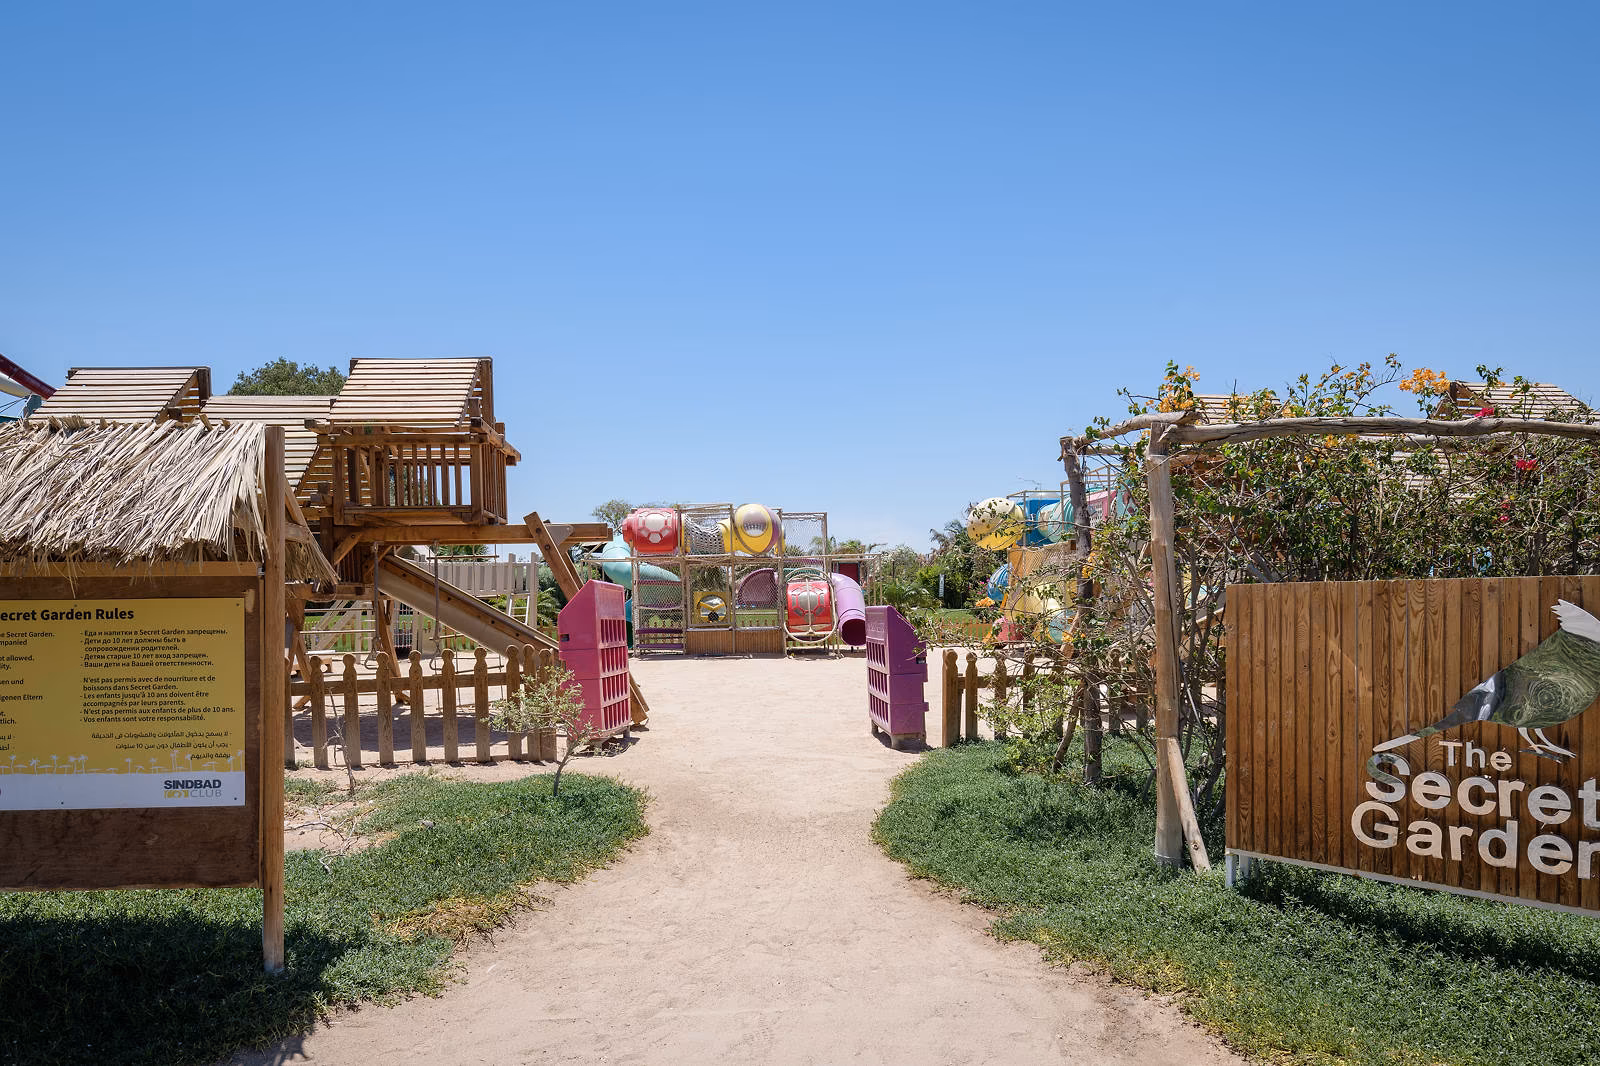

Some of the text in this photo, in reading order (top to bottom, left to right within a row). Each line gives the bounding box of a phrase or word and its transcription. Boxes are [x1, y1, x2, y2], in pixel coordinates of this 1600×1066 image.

[0, 608, 134, 621] ecret Garden Rules
[0, 638, 27, 647] mpanied
[1439, 740, 1512, 772] The
[164, 779, 221, 789] SINDBAD
[1366, 752, 1600, 831] Secret
